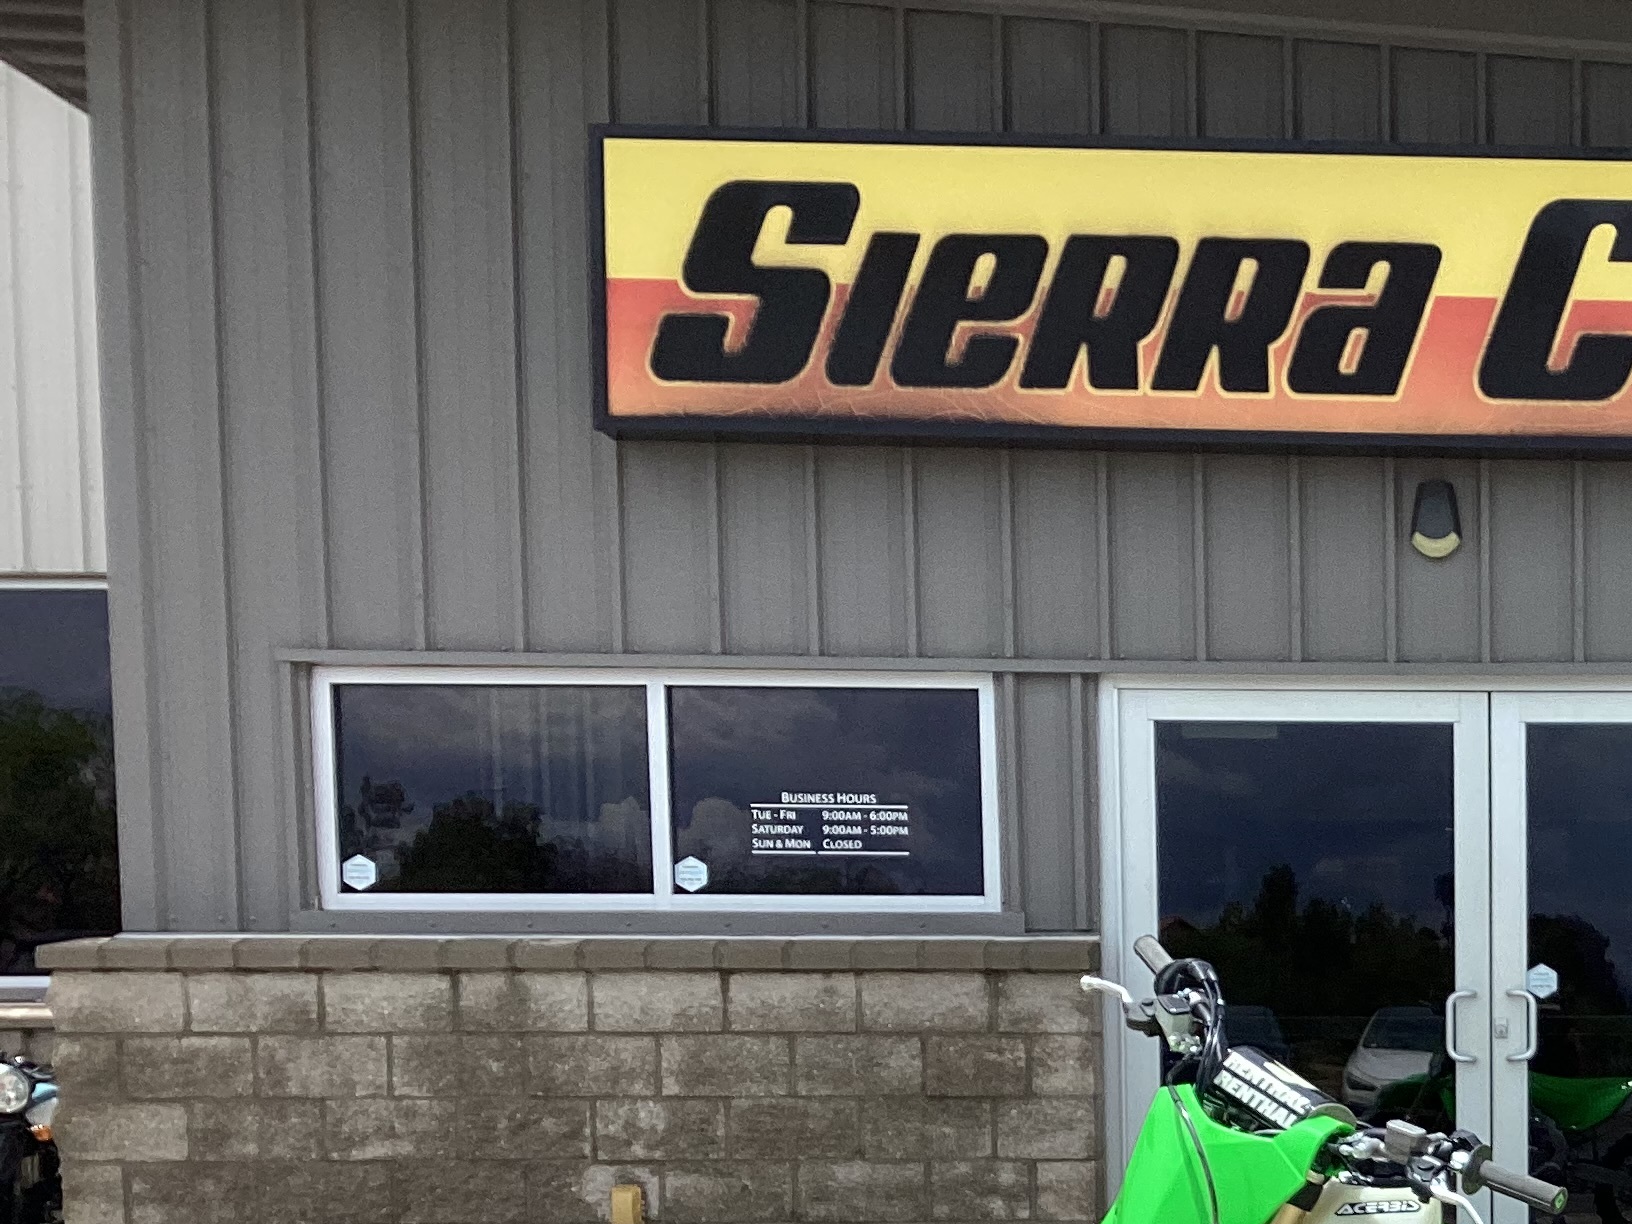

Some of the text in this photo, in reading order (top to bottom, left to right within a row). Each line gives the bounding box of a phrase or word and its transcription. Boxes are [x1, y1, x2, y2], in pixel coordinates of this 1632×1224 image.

[781, 792, 877, 804] BUSINESS HOURS
[822, 810, 862, 821] 9:00AM
[869, 810, 909, 821] 6:00PM
[751, 824, 804, 835] SATURDAY
[822, 824, 862, 835] 9:00AM
[870, 825, 909, 836] 5:00PM
[752, 838, 774, 849] SUN
[785, 838, 811, 849] MON
[823, 838, 863, 850] CLOSED
[1213, 1069, 1297, 1129] RENTHAL
